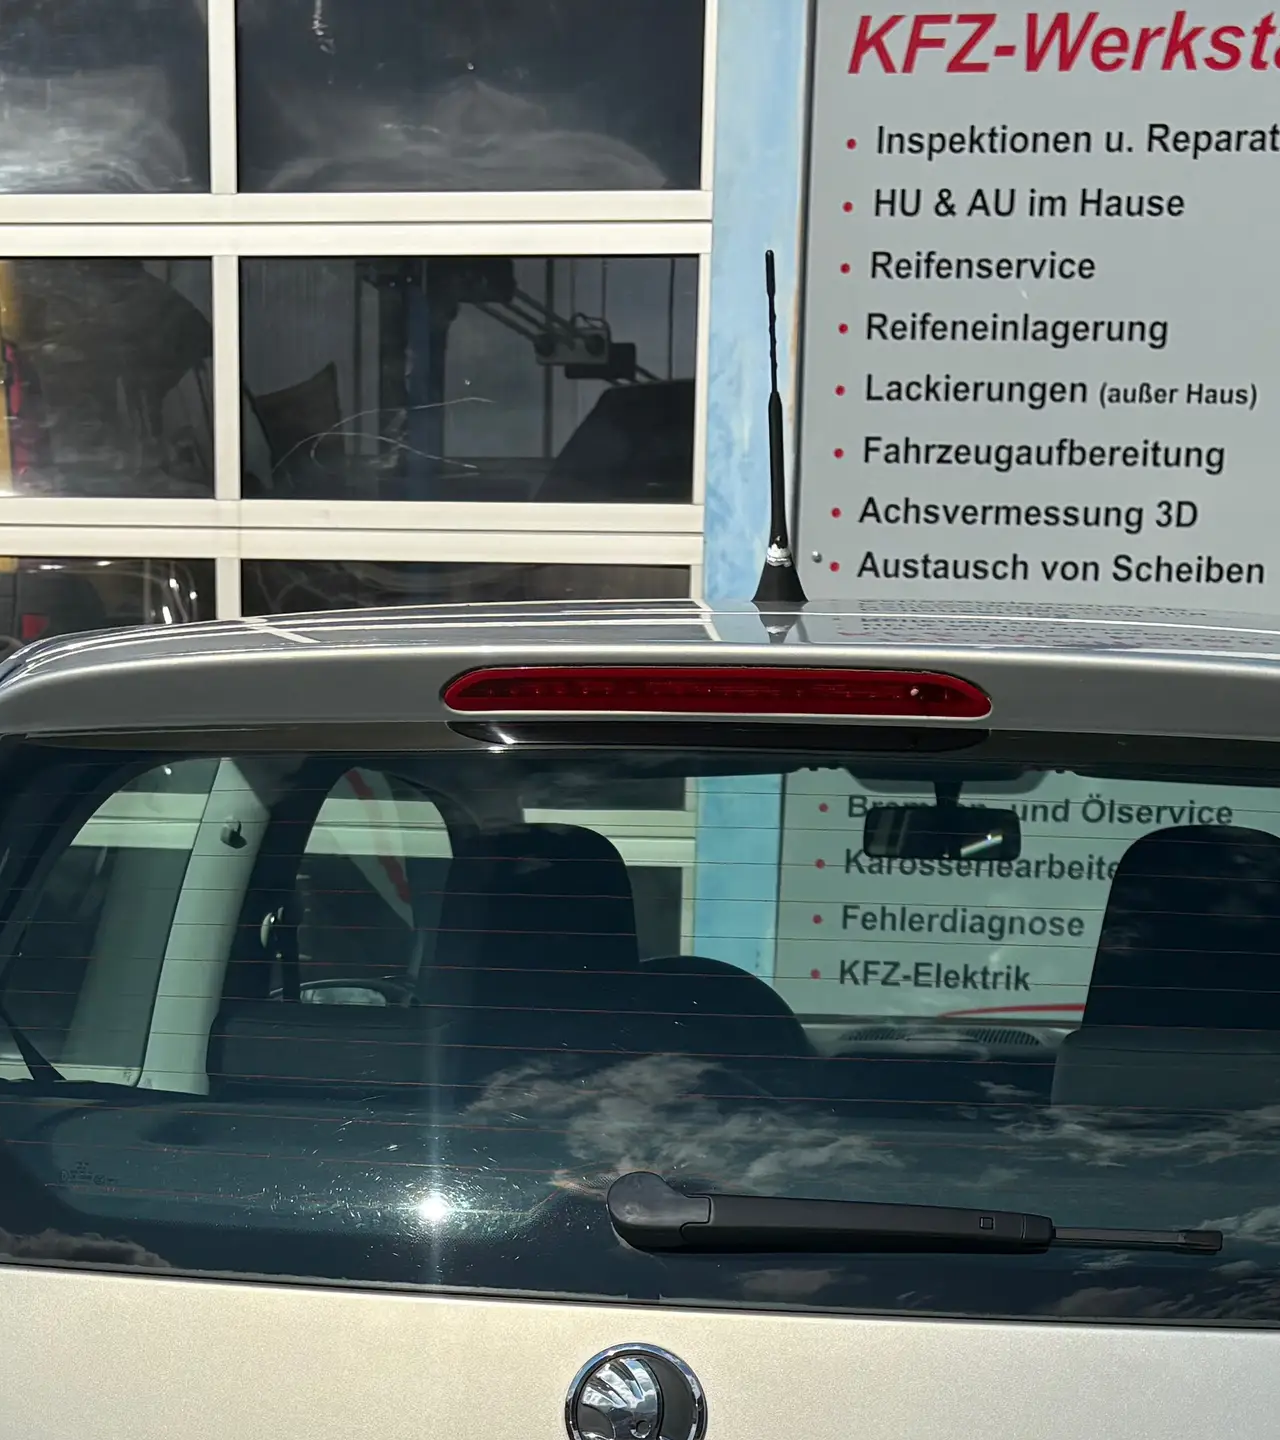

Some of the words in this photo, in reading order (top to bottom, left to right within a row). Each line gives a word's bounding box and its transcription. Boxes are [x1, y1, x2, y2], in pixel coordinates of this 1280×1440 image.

[877, 124, 1092, 162] Inspektionen
[1105, 131, 1133, 153] u.
[874, 188, 922, 218] HU
[933, 187, 957, 218] &
[966, 187, 1017, 218] AU
[1028, 187, 1067, 218] im
[1079, 187, 1185, 218] Hause
[870, 250, 1096, 280] Reifenservice
[866, 311, 1169, 350] Reifeneinlagerung
[865, 373, 1088, 411] Lackierungen
[1099, 381, 1179, 409] (außer
[1186, 382, 1258, 411] Haus)
[863, 435, 1225, 476] Fahrzeugaufbereitung
[857, 496, 1144, 535] Achsvermessung
[1155, 499, 1198, 528] 3D
[856, 550, 1029, 581] Austausch
[1040, 560, 1100, 582] von
[1111, 553, 1265, 585] Scheiben
[1012, 799, 1070, 823] und
[1082, 793, 1233, 825] Ölservice
[845, 848, 1120, 881] Karosseriearbeite
[841, 904, 1085, 941] Fehlerdiagnose
[839, 959, 1031, 991] KFZ-Elektrik
